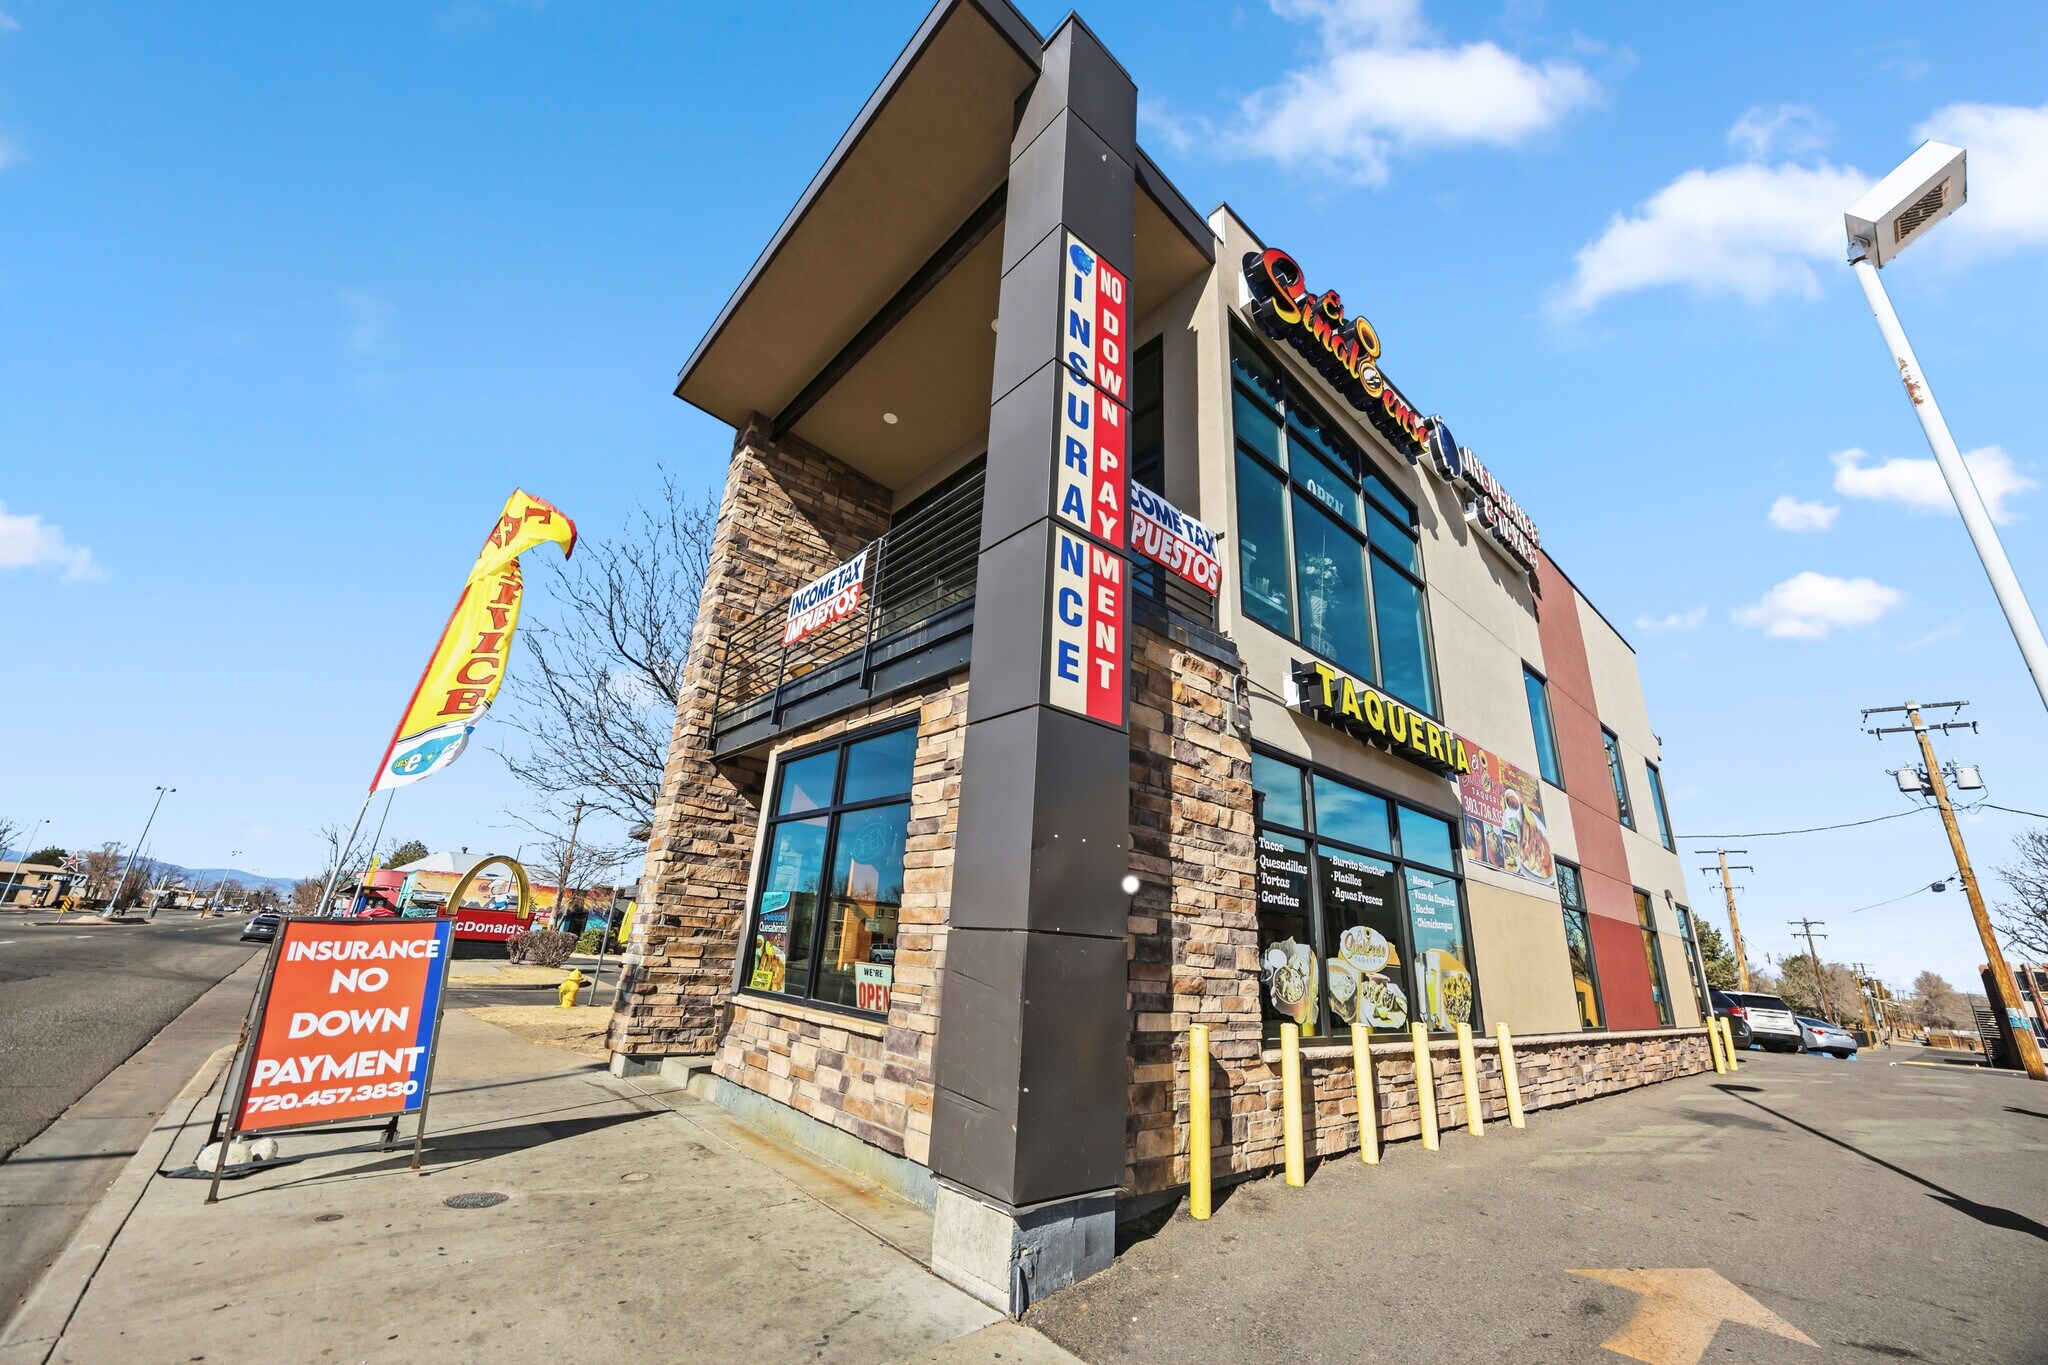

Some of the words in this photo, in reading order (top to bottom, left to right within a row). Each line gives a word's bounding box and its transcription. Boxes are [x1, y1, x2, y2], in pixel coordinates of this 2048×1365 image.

[1100, 267, 1122, 305] NO
[1098, 308, 1123, 427] DOWN
[1058, 273, 1090, 684] INSURANCE
[1131, 513, 1218, 591] PUESTOS
[1093, 447, 1120, 689] PAYMENT
[790, 575, 837, 618] INCOME
[837, 558, 863, 590] TAX
[1315, 661, 1472, 775] TAQUERIA
[1258, 836, 1284, 853] Tacos
[1259, 854, 1308, 875] Quesadillas
[1332, 855, 1358, 871] Burrito
[1358, 862, 1386, 877] Smother
[1333, 870, 1362, 887] Platillos
[1260, 871, 1290, 888] Tortas
[1261, 890, 1299, 907] Gorditas
[1334, 887, 1358, 902] Aguas
[1357, 891, 1383, 906] Frescas
[455, 920, 525, 935] cDonald's
[286, 939, 441, 962] INSURANCE
[329, 967, 389, 994] NO
[864, 968, 883, 978] WE'RE
[859, 981, 890, 1012] OPEN
[288, 1006, 410, 1039] DOWN
[251, 1046, 425, 1088] PAYMENT
[247, 1079, 418, 1114] 720.457.3830
